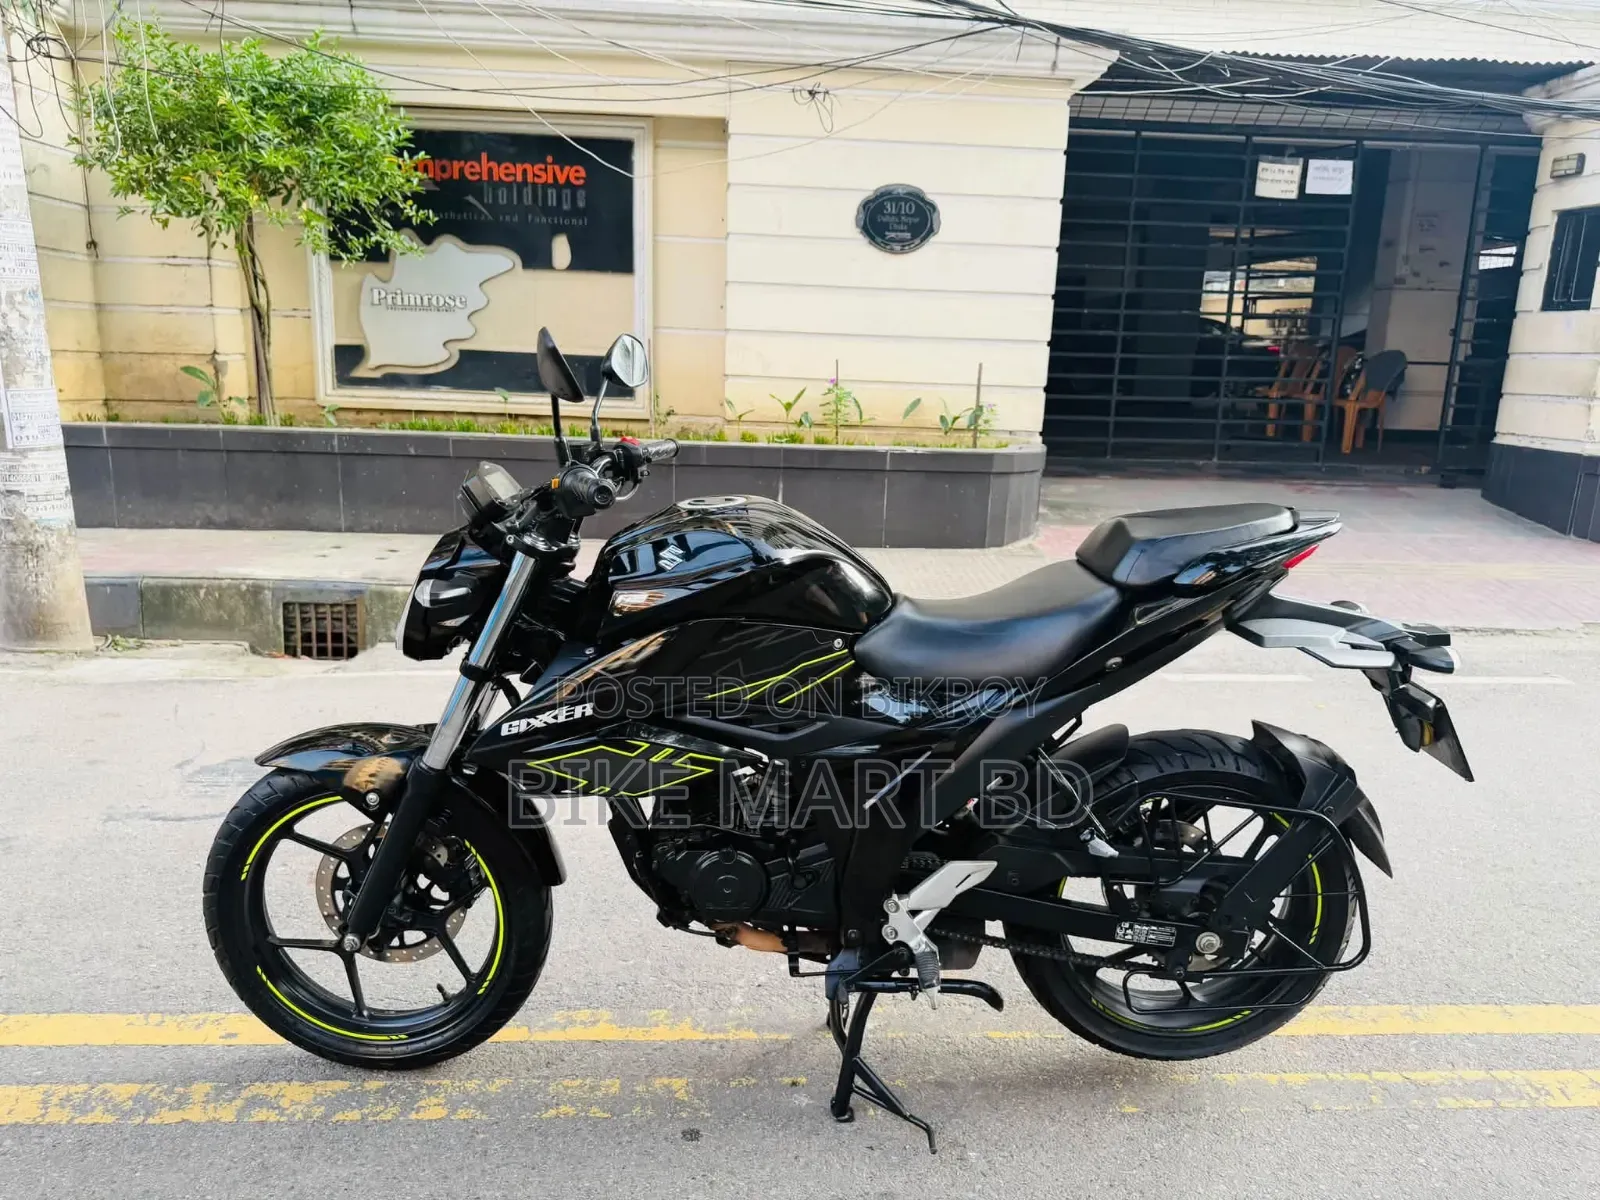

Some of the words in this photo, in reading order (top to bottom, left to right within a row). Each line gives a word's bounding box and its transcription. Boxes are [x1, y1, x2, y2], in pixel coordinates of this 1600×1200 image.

[883, 201, 916, 215] 31/10
[371, 288, 468, 310] Primrose
[501, 702, 594, 737] GIXXER
